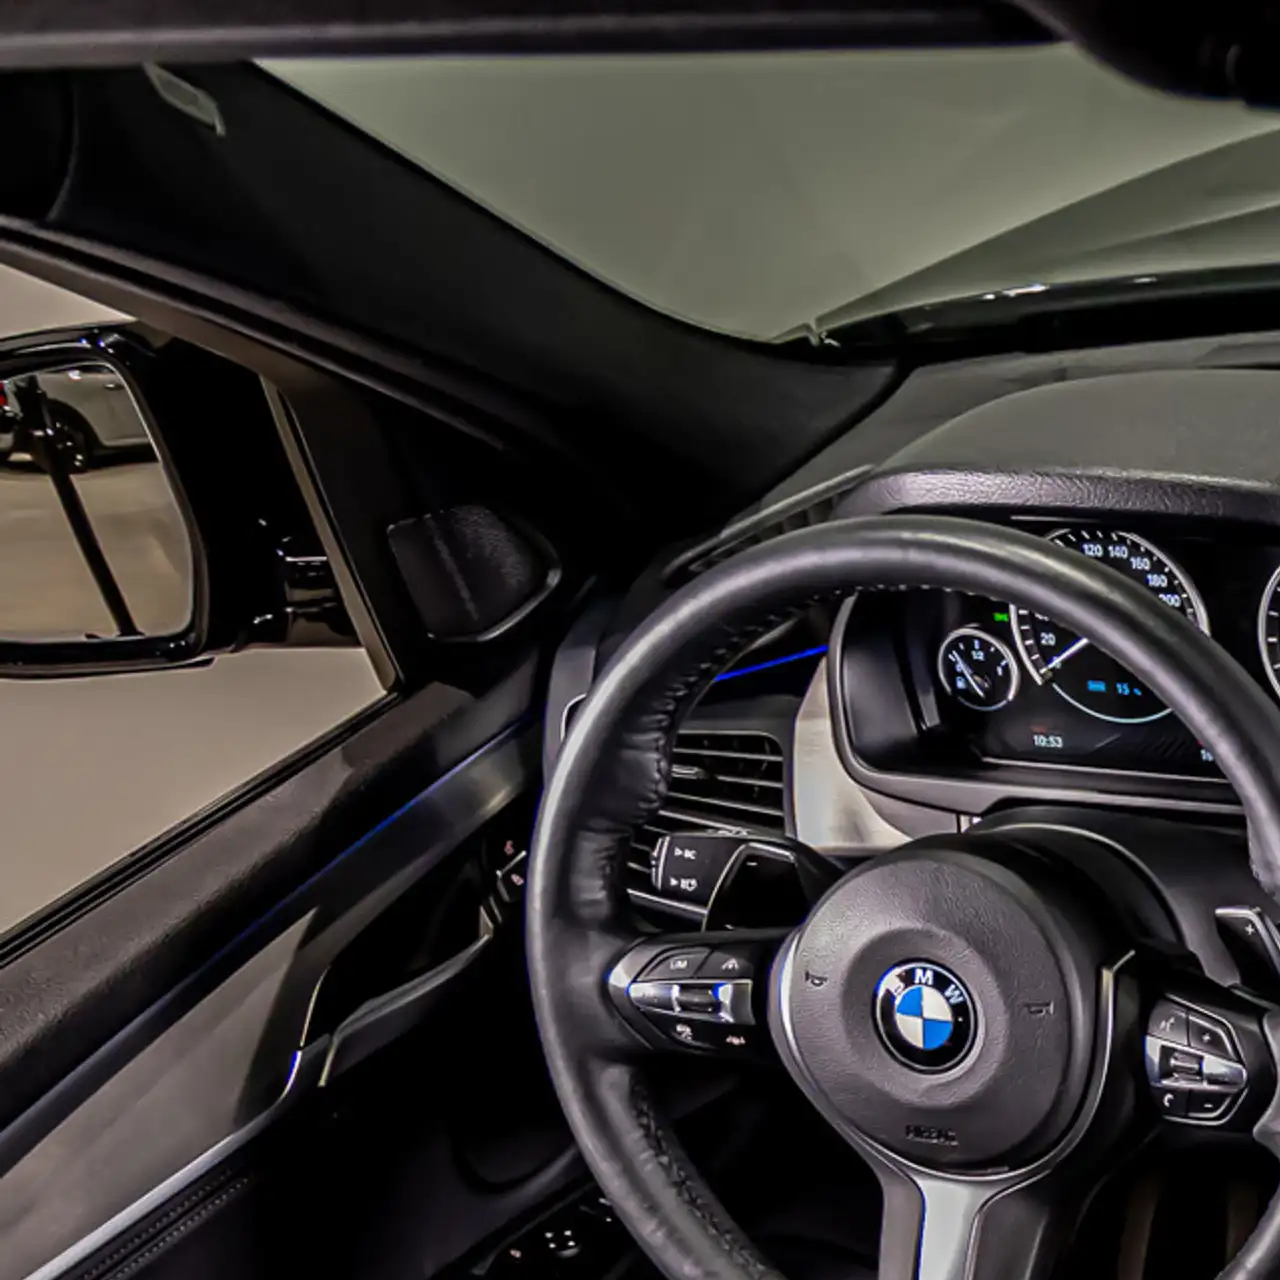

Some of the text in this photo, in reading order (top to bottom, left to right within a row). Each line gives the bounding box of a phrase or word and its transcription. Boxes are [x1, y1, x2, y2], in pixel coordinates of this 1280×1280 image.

[1083, 543, 1103, 557] 120
[1108, 545, 1128, 558] 140
[1130, 557, 1150, 570] 160
[1148, 574, 1168, 587] 180
[1040, 632, 1056, 645] 20
[1033, 734, 1063, 748] 10:53
